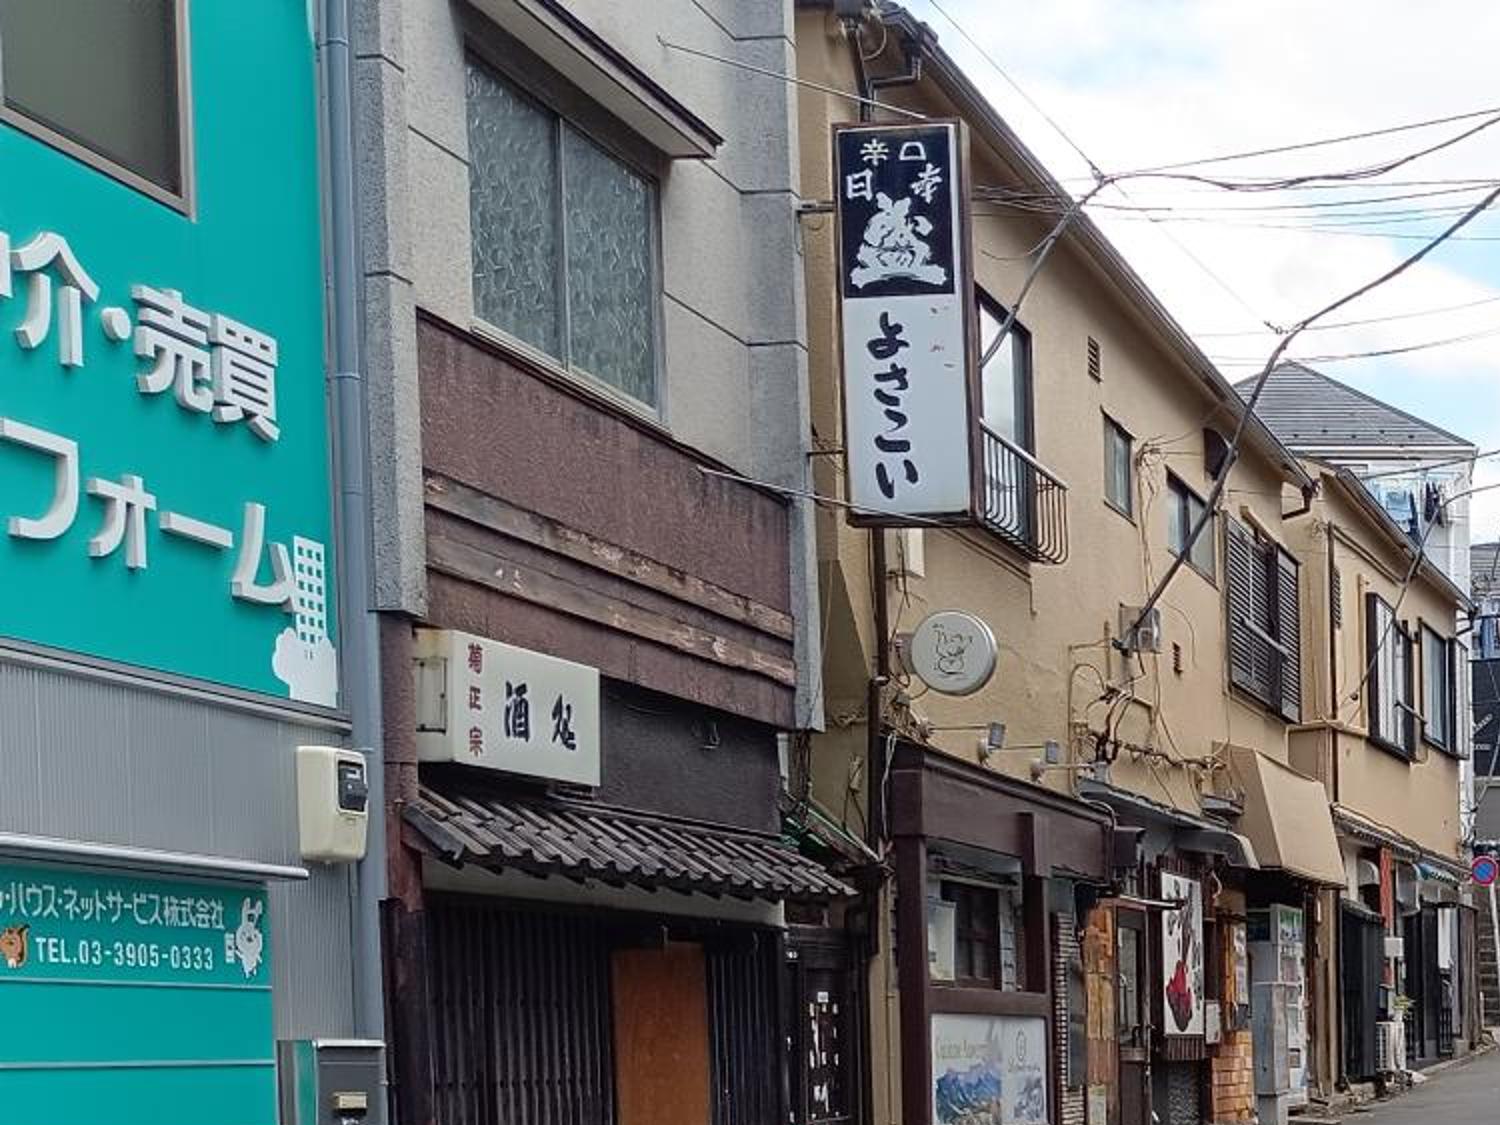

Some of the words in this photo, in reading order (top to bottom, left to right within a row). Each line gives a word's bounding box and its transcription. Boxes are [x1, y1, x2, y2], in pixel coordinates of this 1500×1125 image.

[0, 230, 280, 442] 介・売買
[867, 311, 919, 499] よさこい
[0, 416, 299, 614] フォーム
[0, 881, 225, 931] ・ハウス・ネットサービス株式会社
[35, 936, 214, 971] TEL.03-3905-0333
